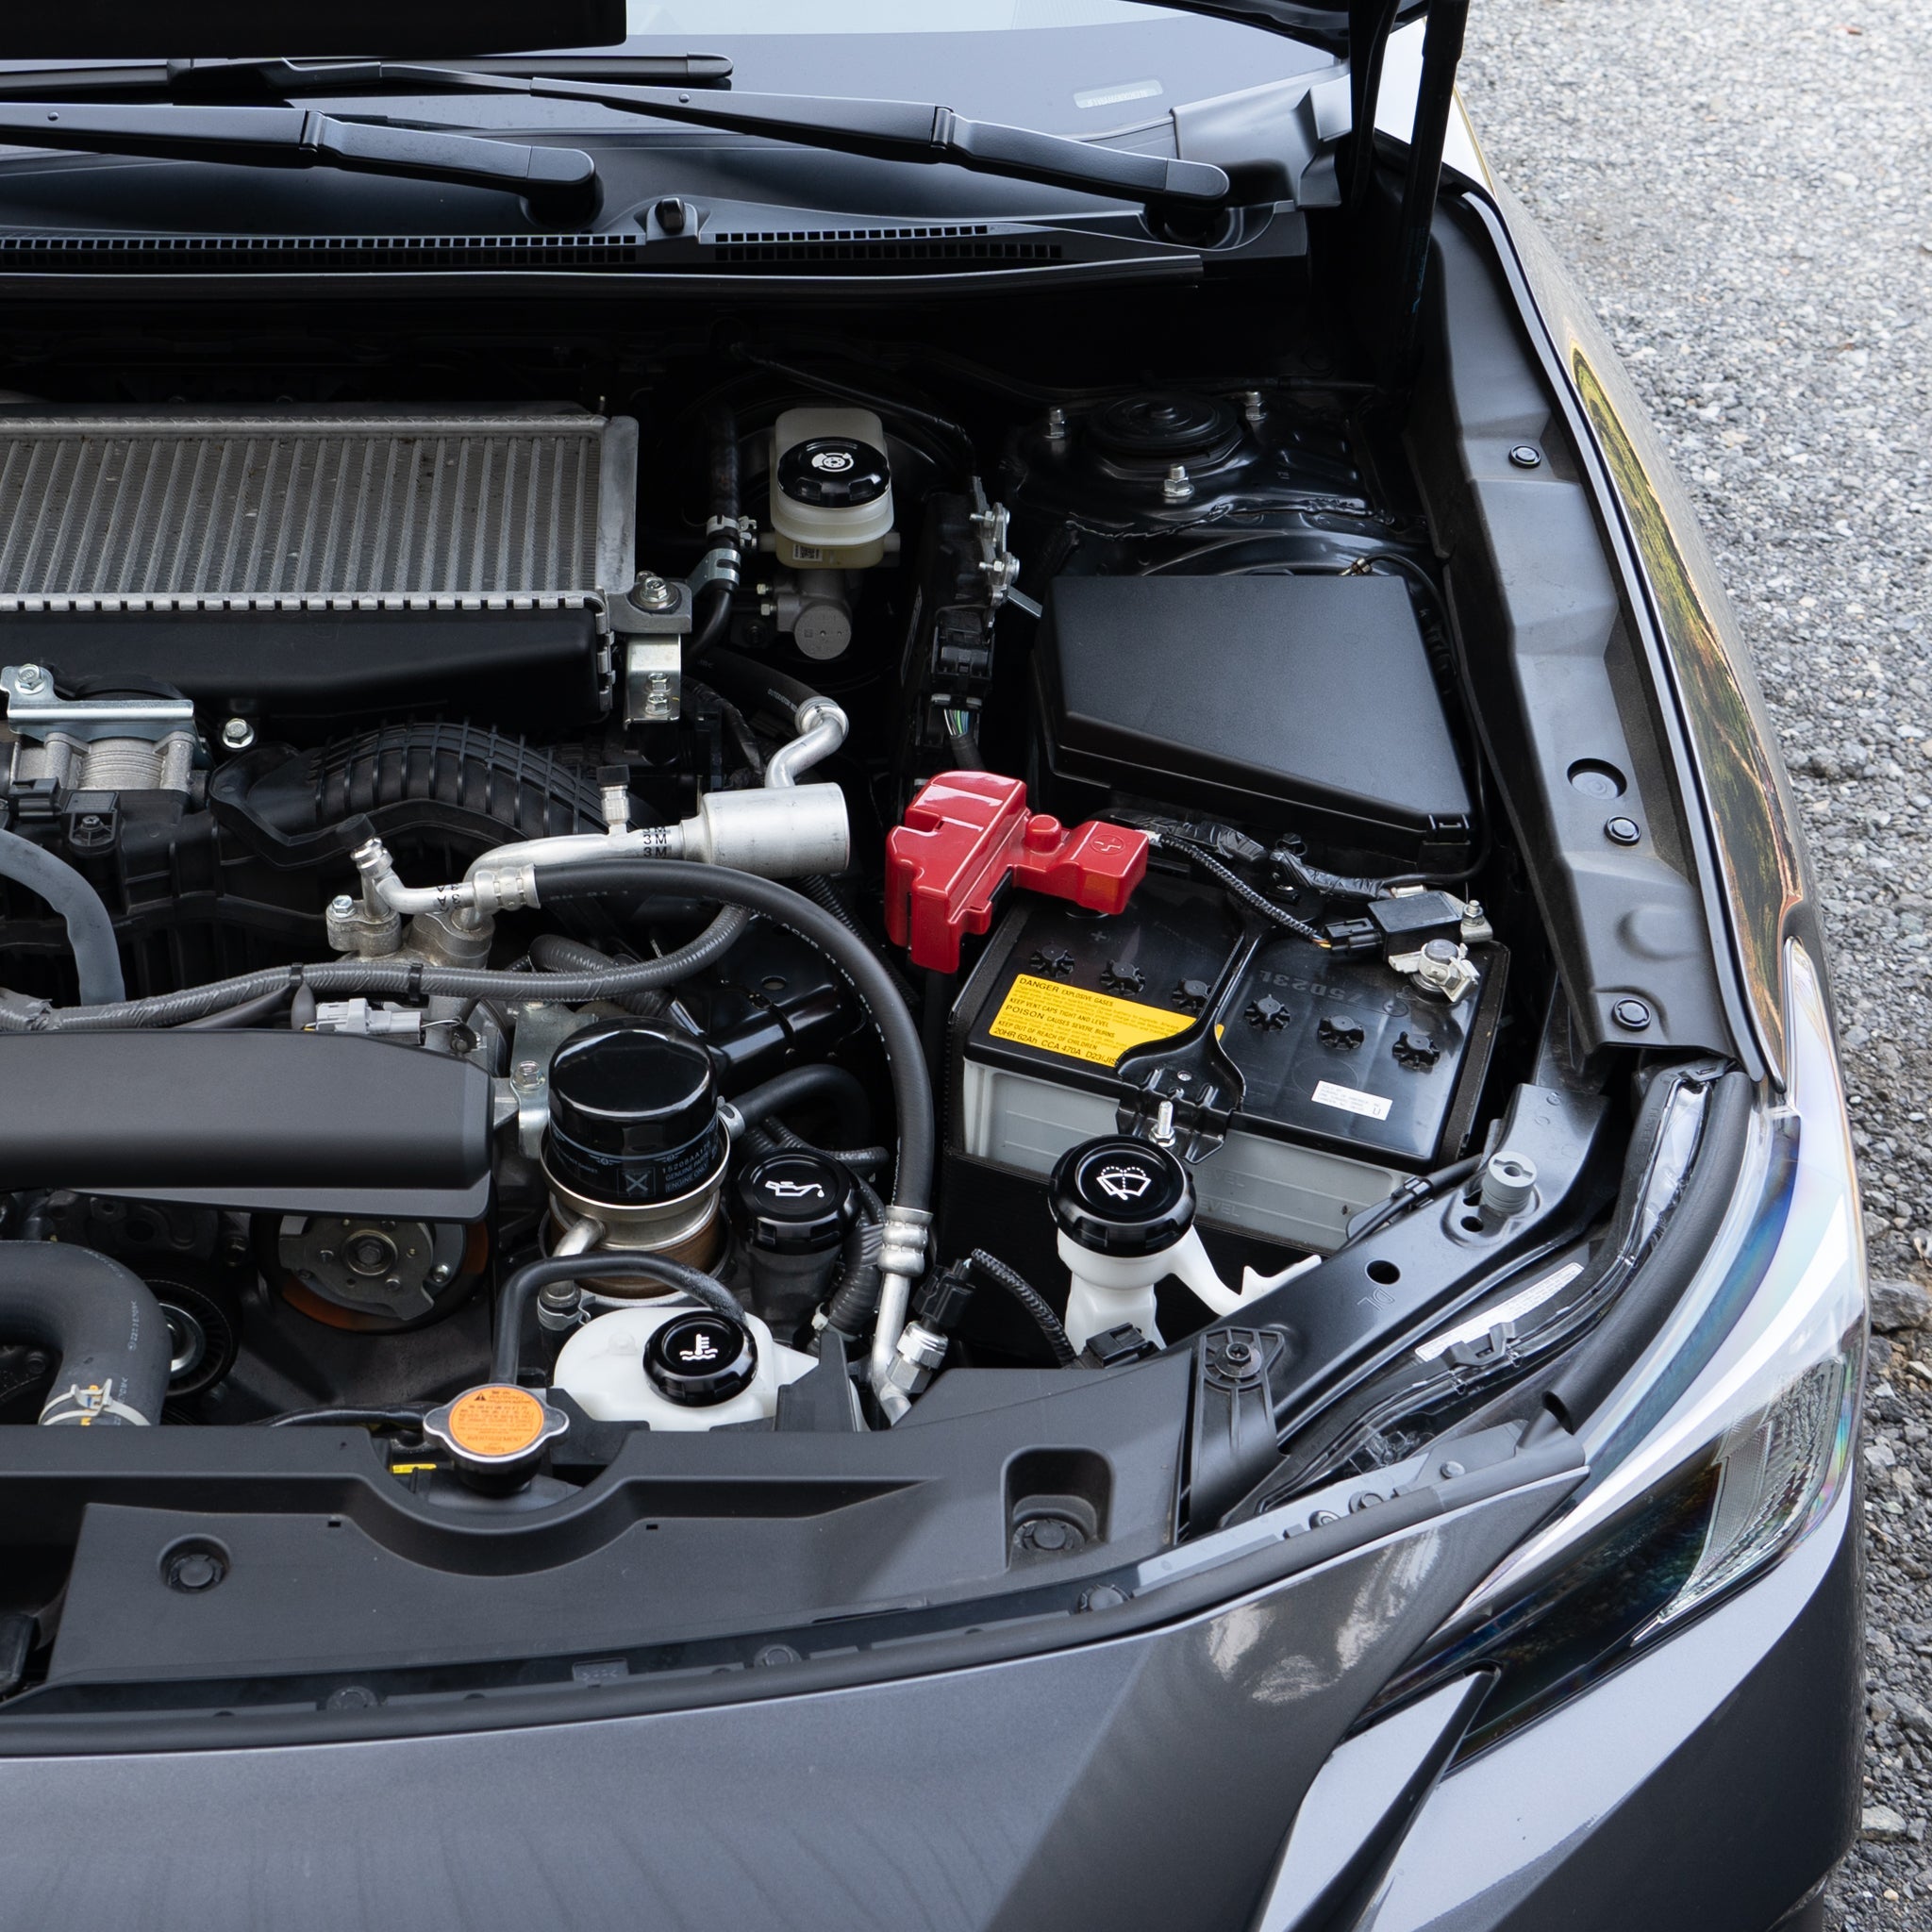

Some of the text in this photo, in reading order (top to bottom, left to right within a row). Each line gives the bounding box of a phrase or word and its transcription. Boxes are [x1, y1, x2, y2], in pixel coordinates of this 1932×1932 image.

[1019, 977, 1113, 1007] DANGER EXPLOSIVE GASES
[1260, 970, 1363, 1002] 75D23L
[1006, 1005, 1115, 1038] POISON CAUSES SEVERE BURNS
[1009, 997, 1109, 1027] KEEP VENT CAPS TIGHT AND LEVEL
[993, 1027, 1017, 1038] 20HR
[1018, 1033, 1039, 1044] 62Ah
[1041, 1040, 1059, 1050] CCA
[1061, 1044, 1082, 1056] 470A
[998, 1020, 1014, 1028] KEEP
[1014, 1024, 1027, 1032] OUT
[1037, 1029, 1058, 1040] REACH
[1067, 1037, 1098, 1050] CHILDREN
